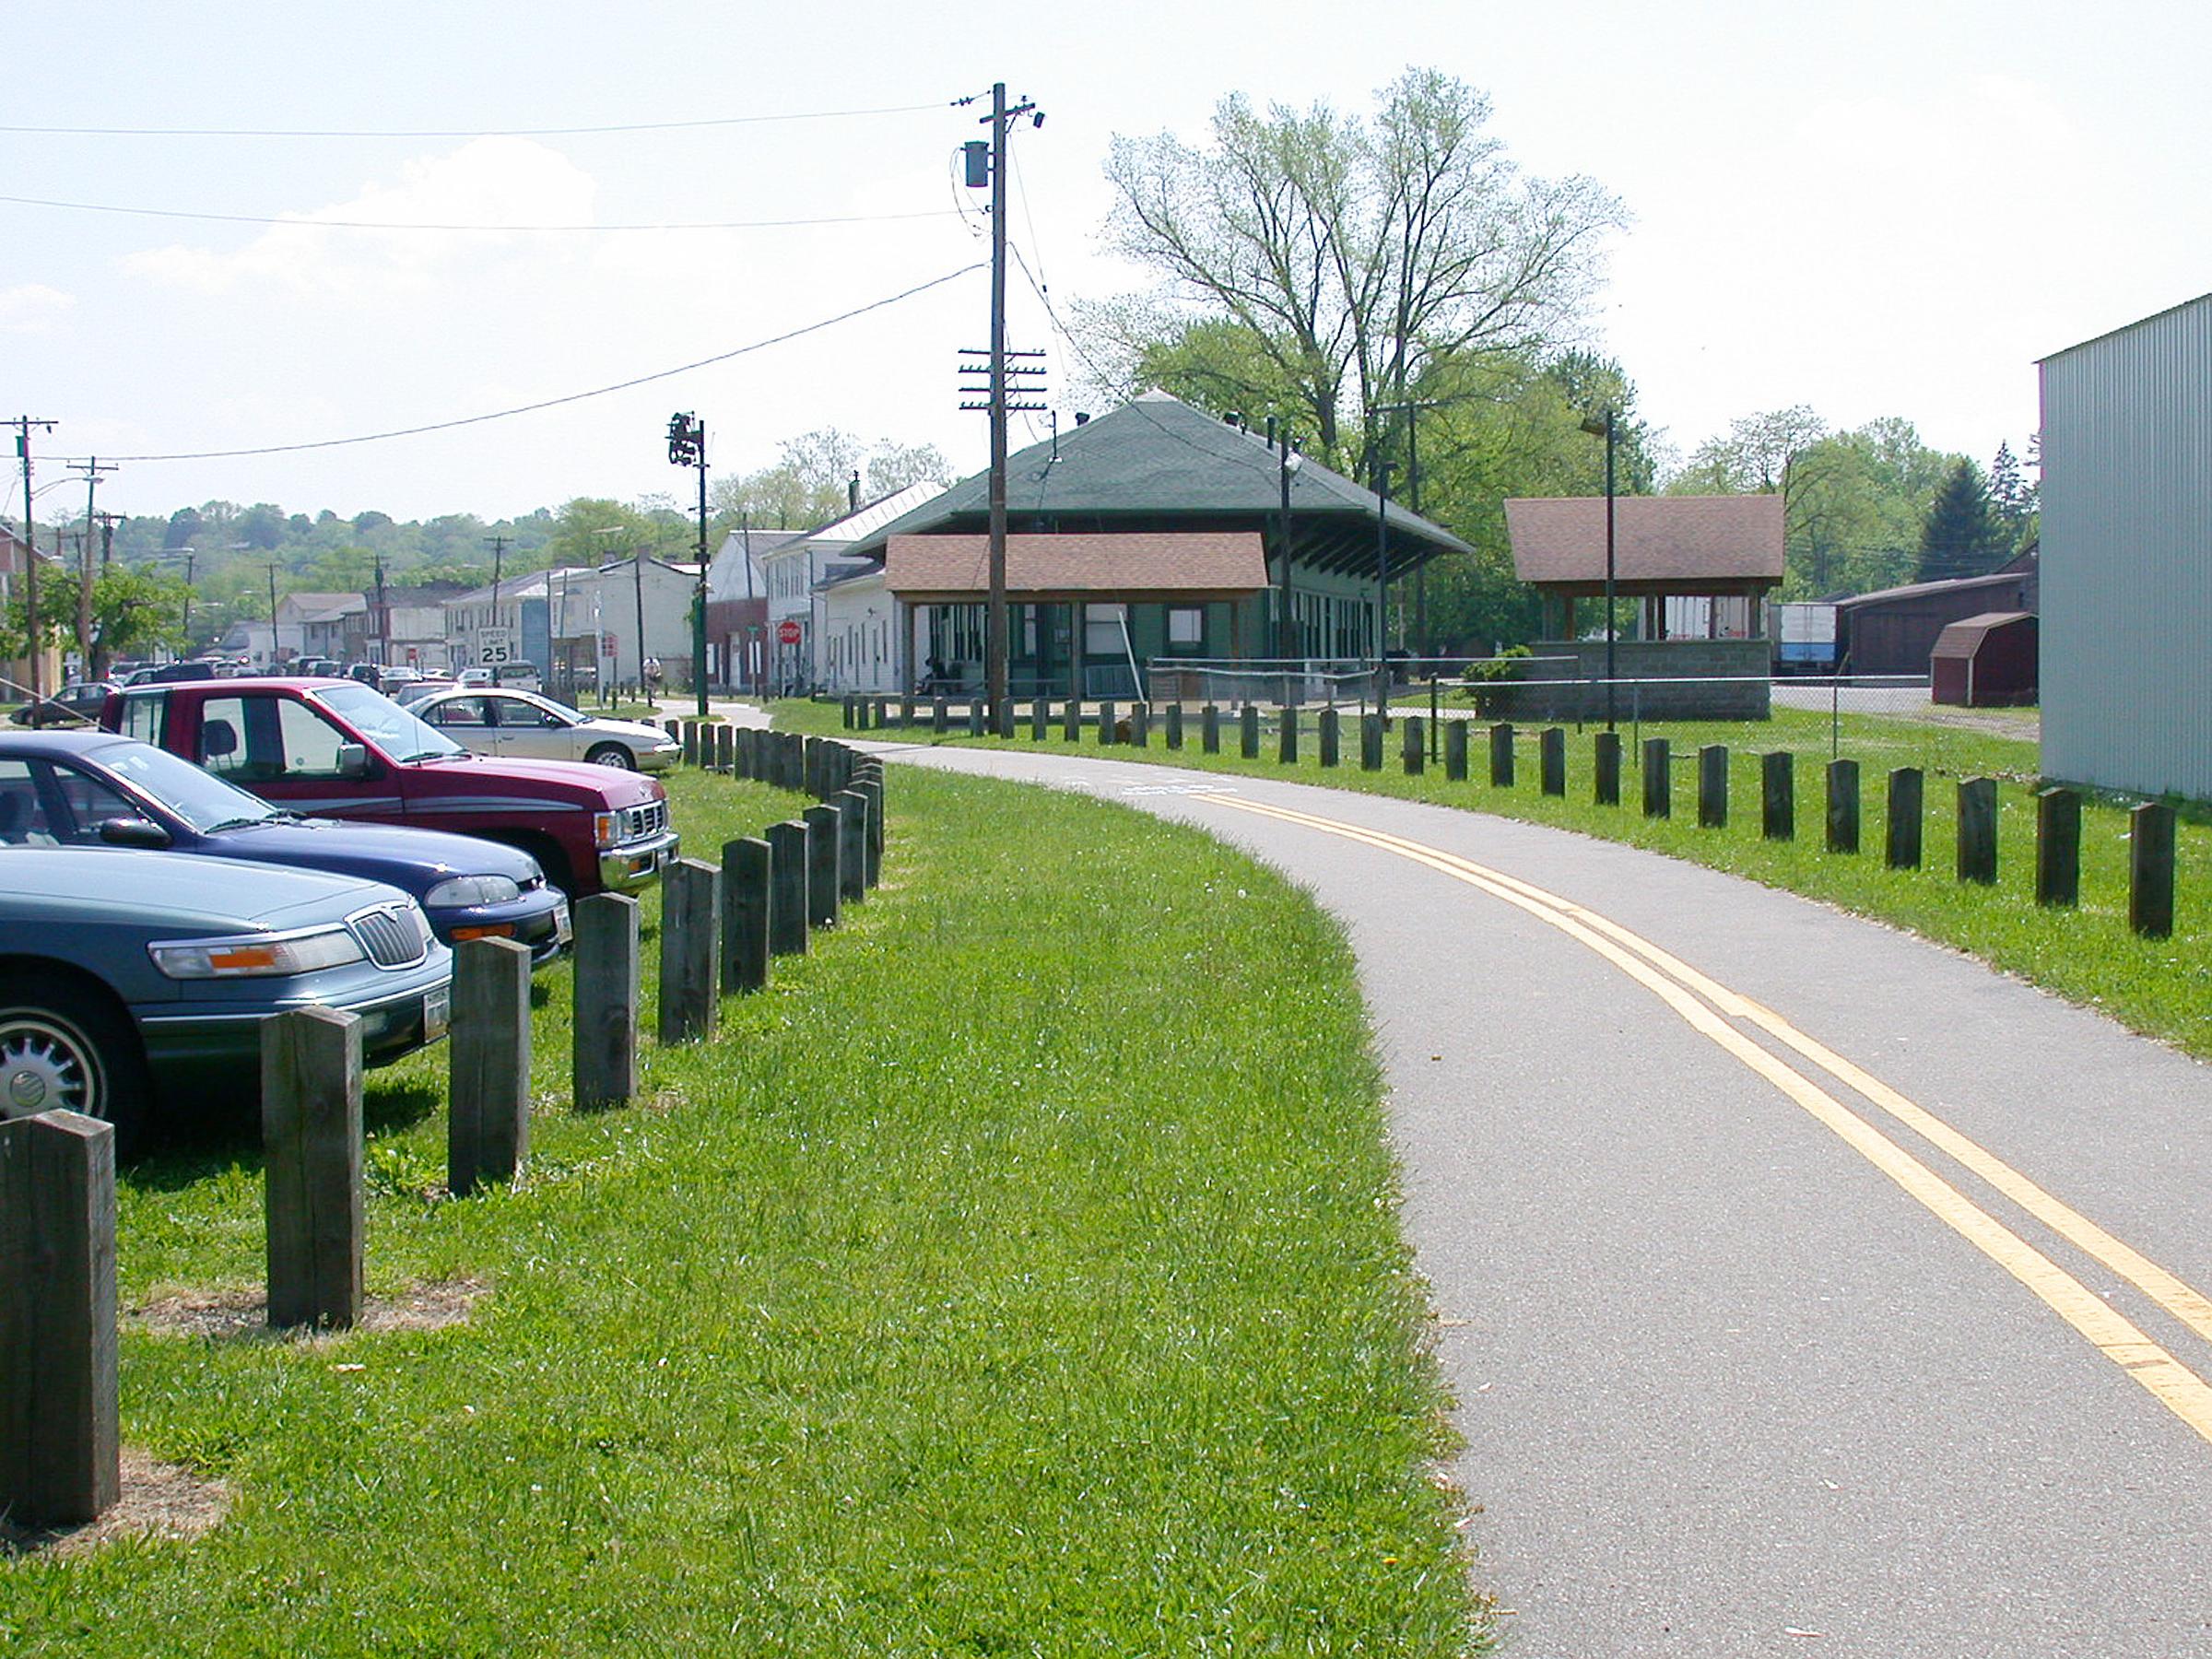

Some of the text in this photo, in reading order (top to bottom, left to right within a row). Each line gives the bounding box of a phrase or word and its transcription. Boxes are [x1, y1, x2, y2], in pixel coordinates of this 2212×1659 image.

[480, 629, 506, 638] SPEED
[779, 628, 799, 638] STOP
[482, 647, 507, 662] 25
